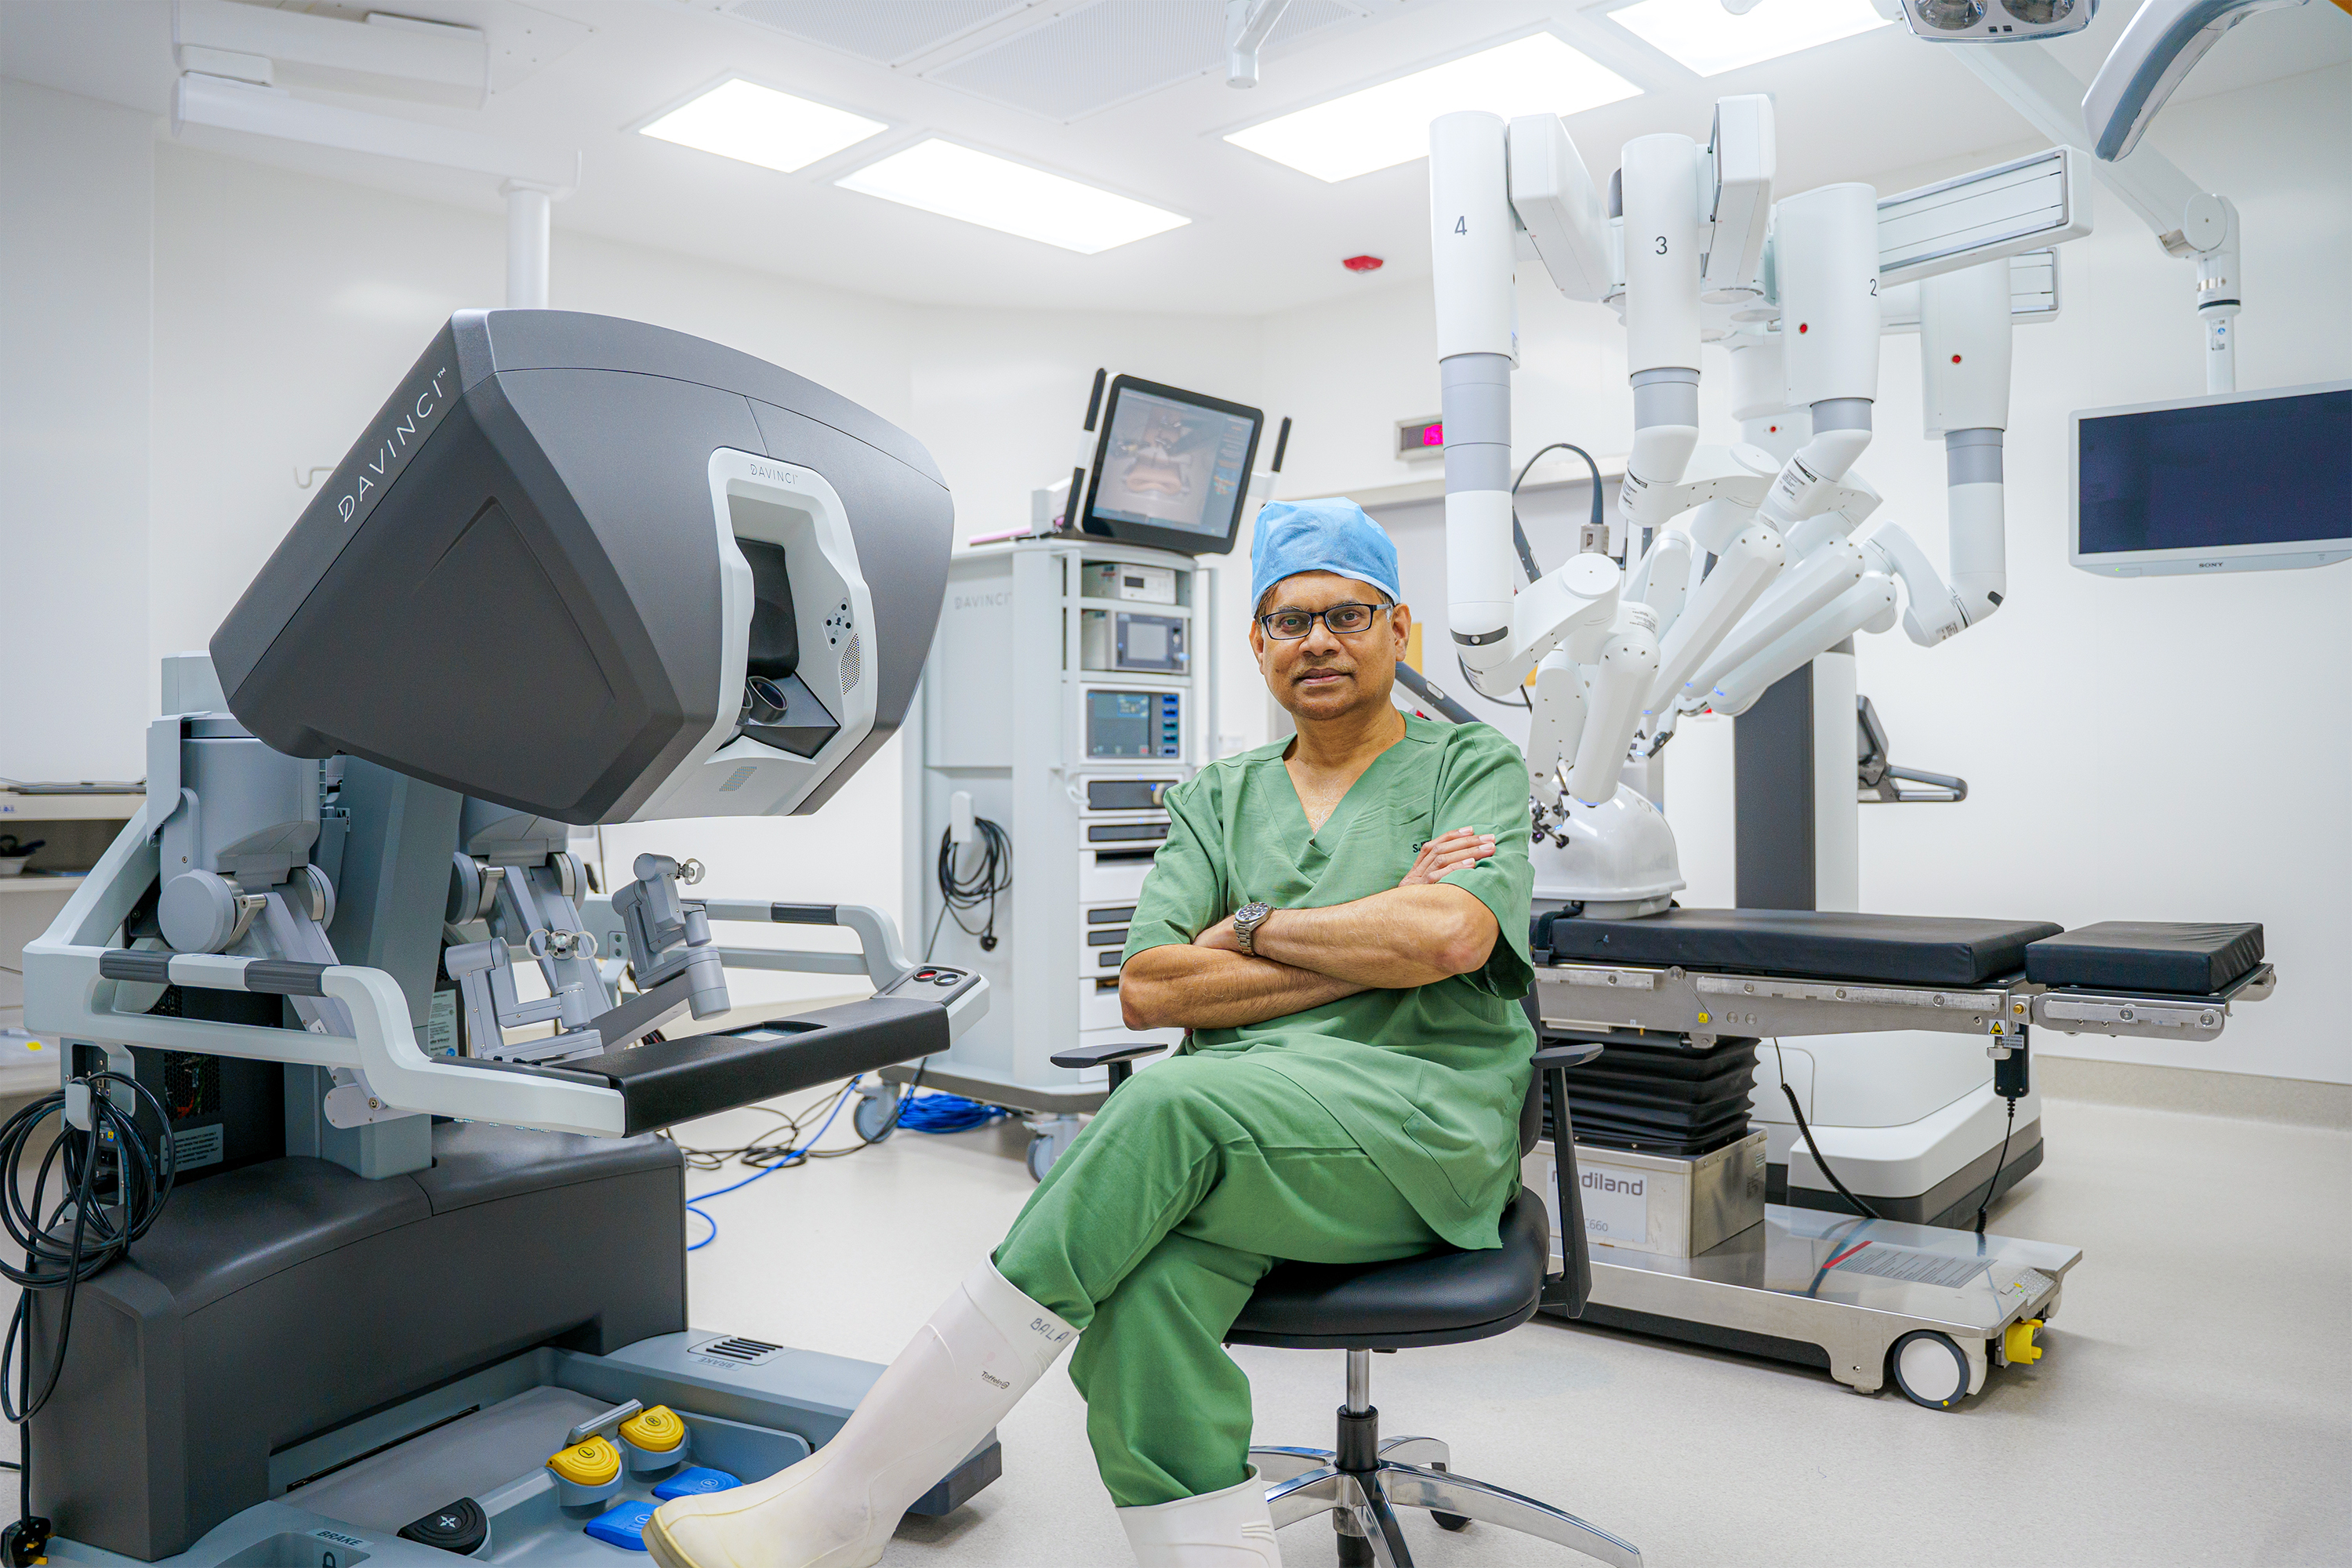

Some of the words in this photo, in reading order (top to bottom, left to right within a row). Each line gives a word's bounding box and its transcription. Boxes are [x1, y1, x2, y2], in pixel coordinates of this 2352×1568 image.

[1454, 216, 1467, 235] 4
[1655, 236, 1668, 255] 3
[1870, 278, 1877, 296] 2
[1552, 1170, 1643, 1196] diland
[1030, 1318, 1069, 1343] BALA
[698, 1356, 735, 1368] BRAKE
[317, 1530, 363, 1546] BRAKE
